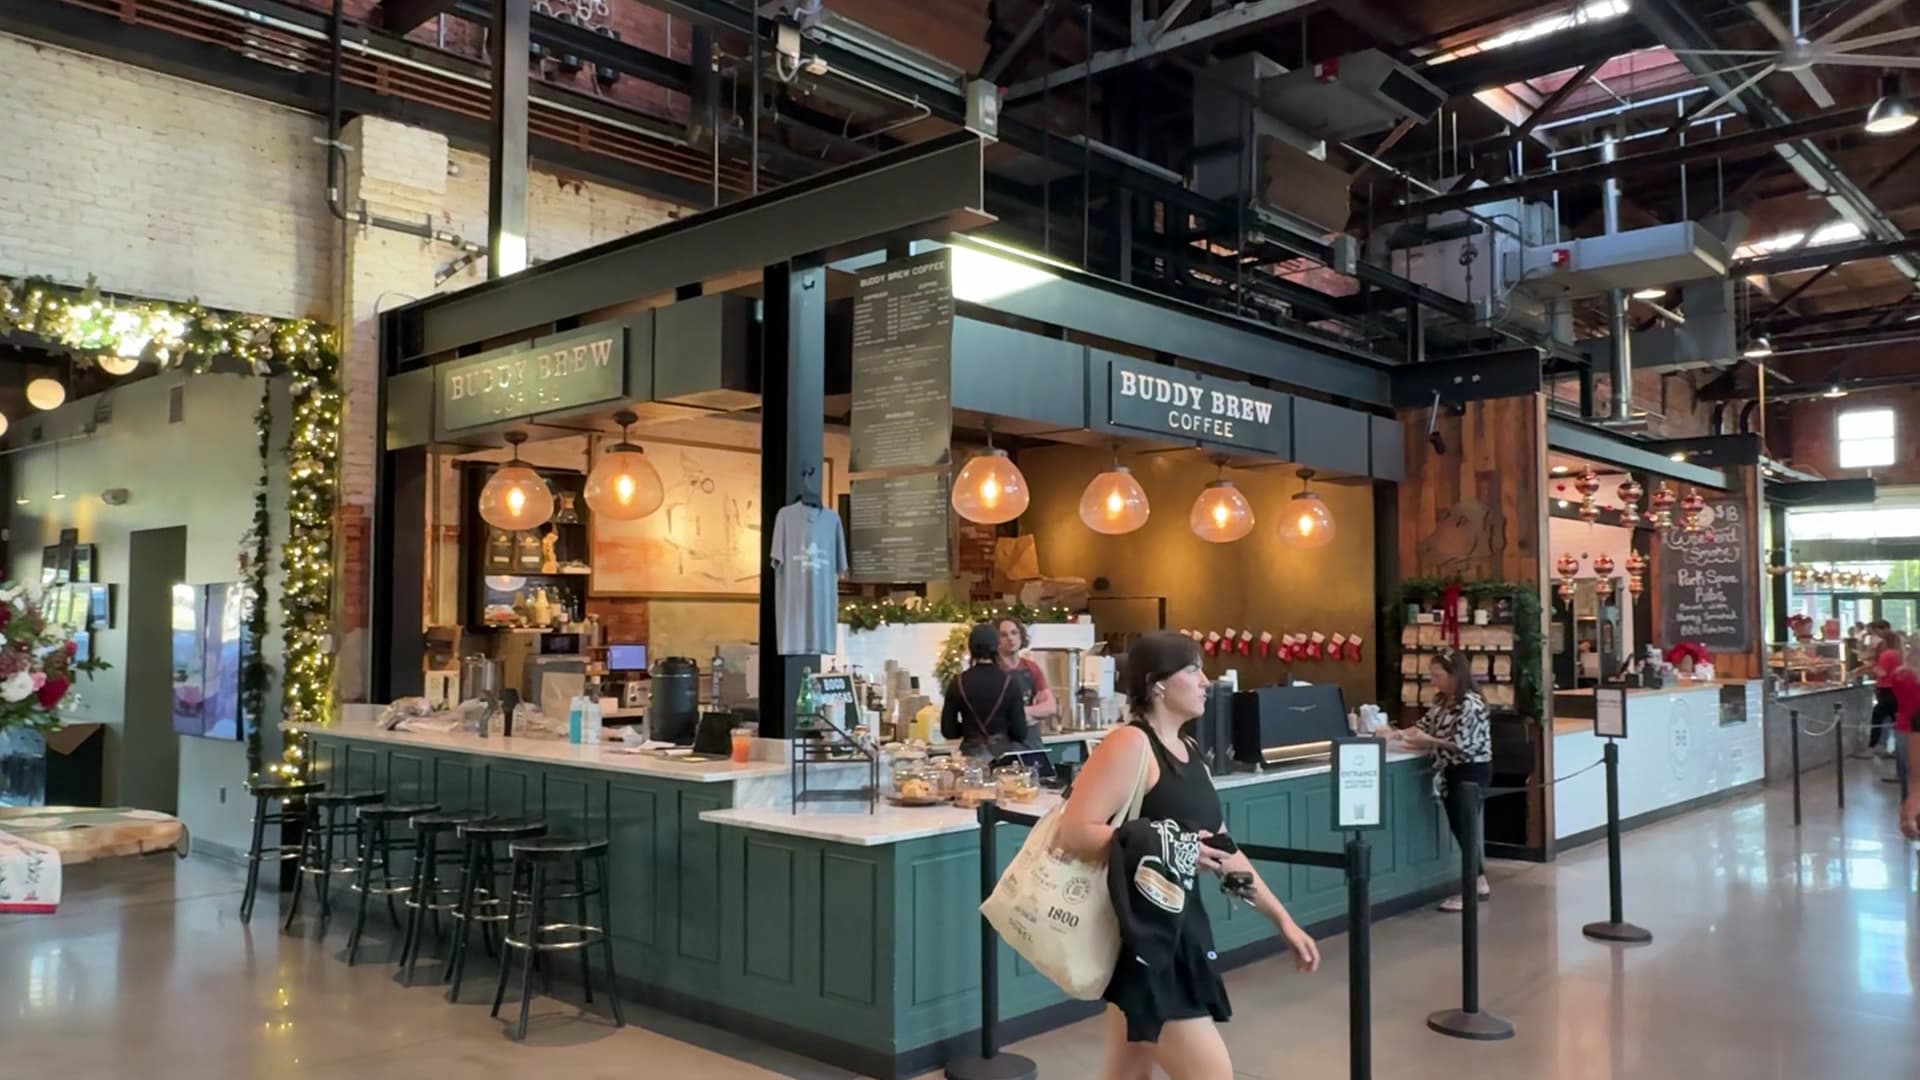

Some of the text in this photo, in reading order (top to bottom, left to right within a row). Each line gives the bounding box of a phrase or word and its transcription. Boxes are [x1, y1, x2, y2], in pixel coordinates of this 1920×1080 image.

[860, 261, 945, 288] BUDDY BREW COFFEE
[451, 360, 527, 400] BUDDY
[537, 339, 613, 380] BREW
[1120, 370, 1273, 425] BUDDY BREW
[1168, 411, 1234, 438] COFFEE
[1047, 905, 1080, 928] 1800
